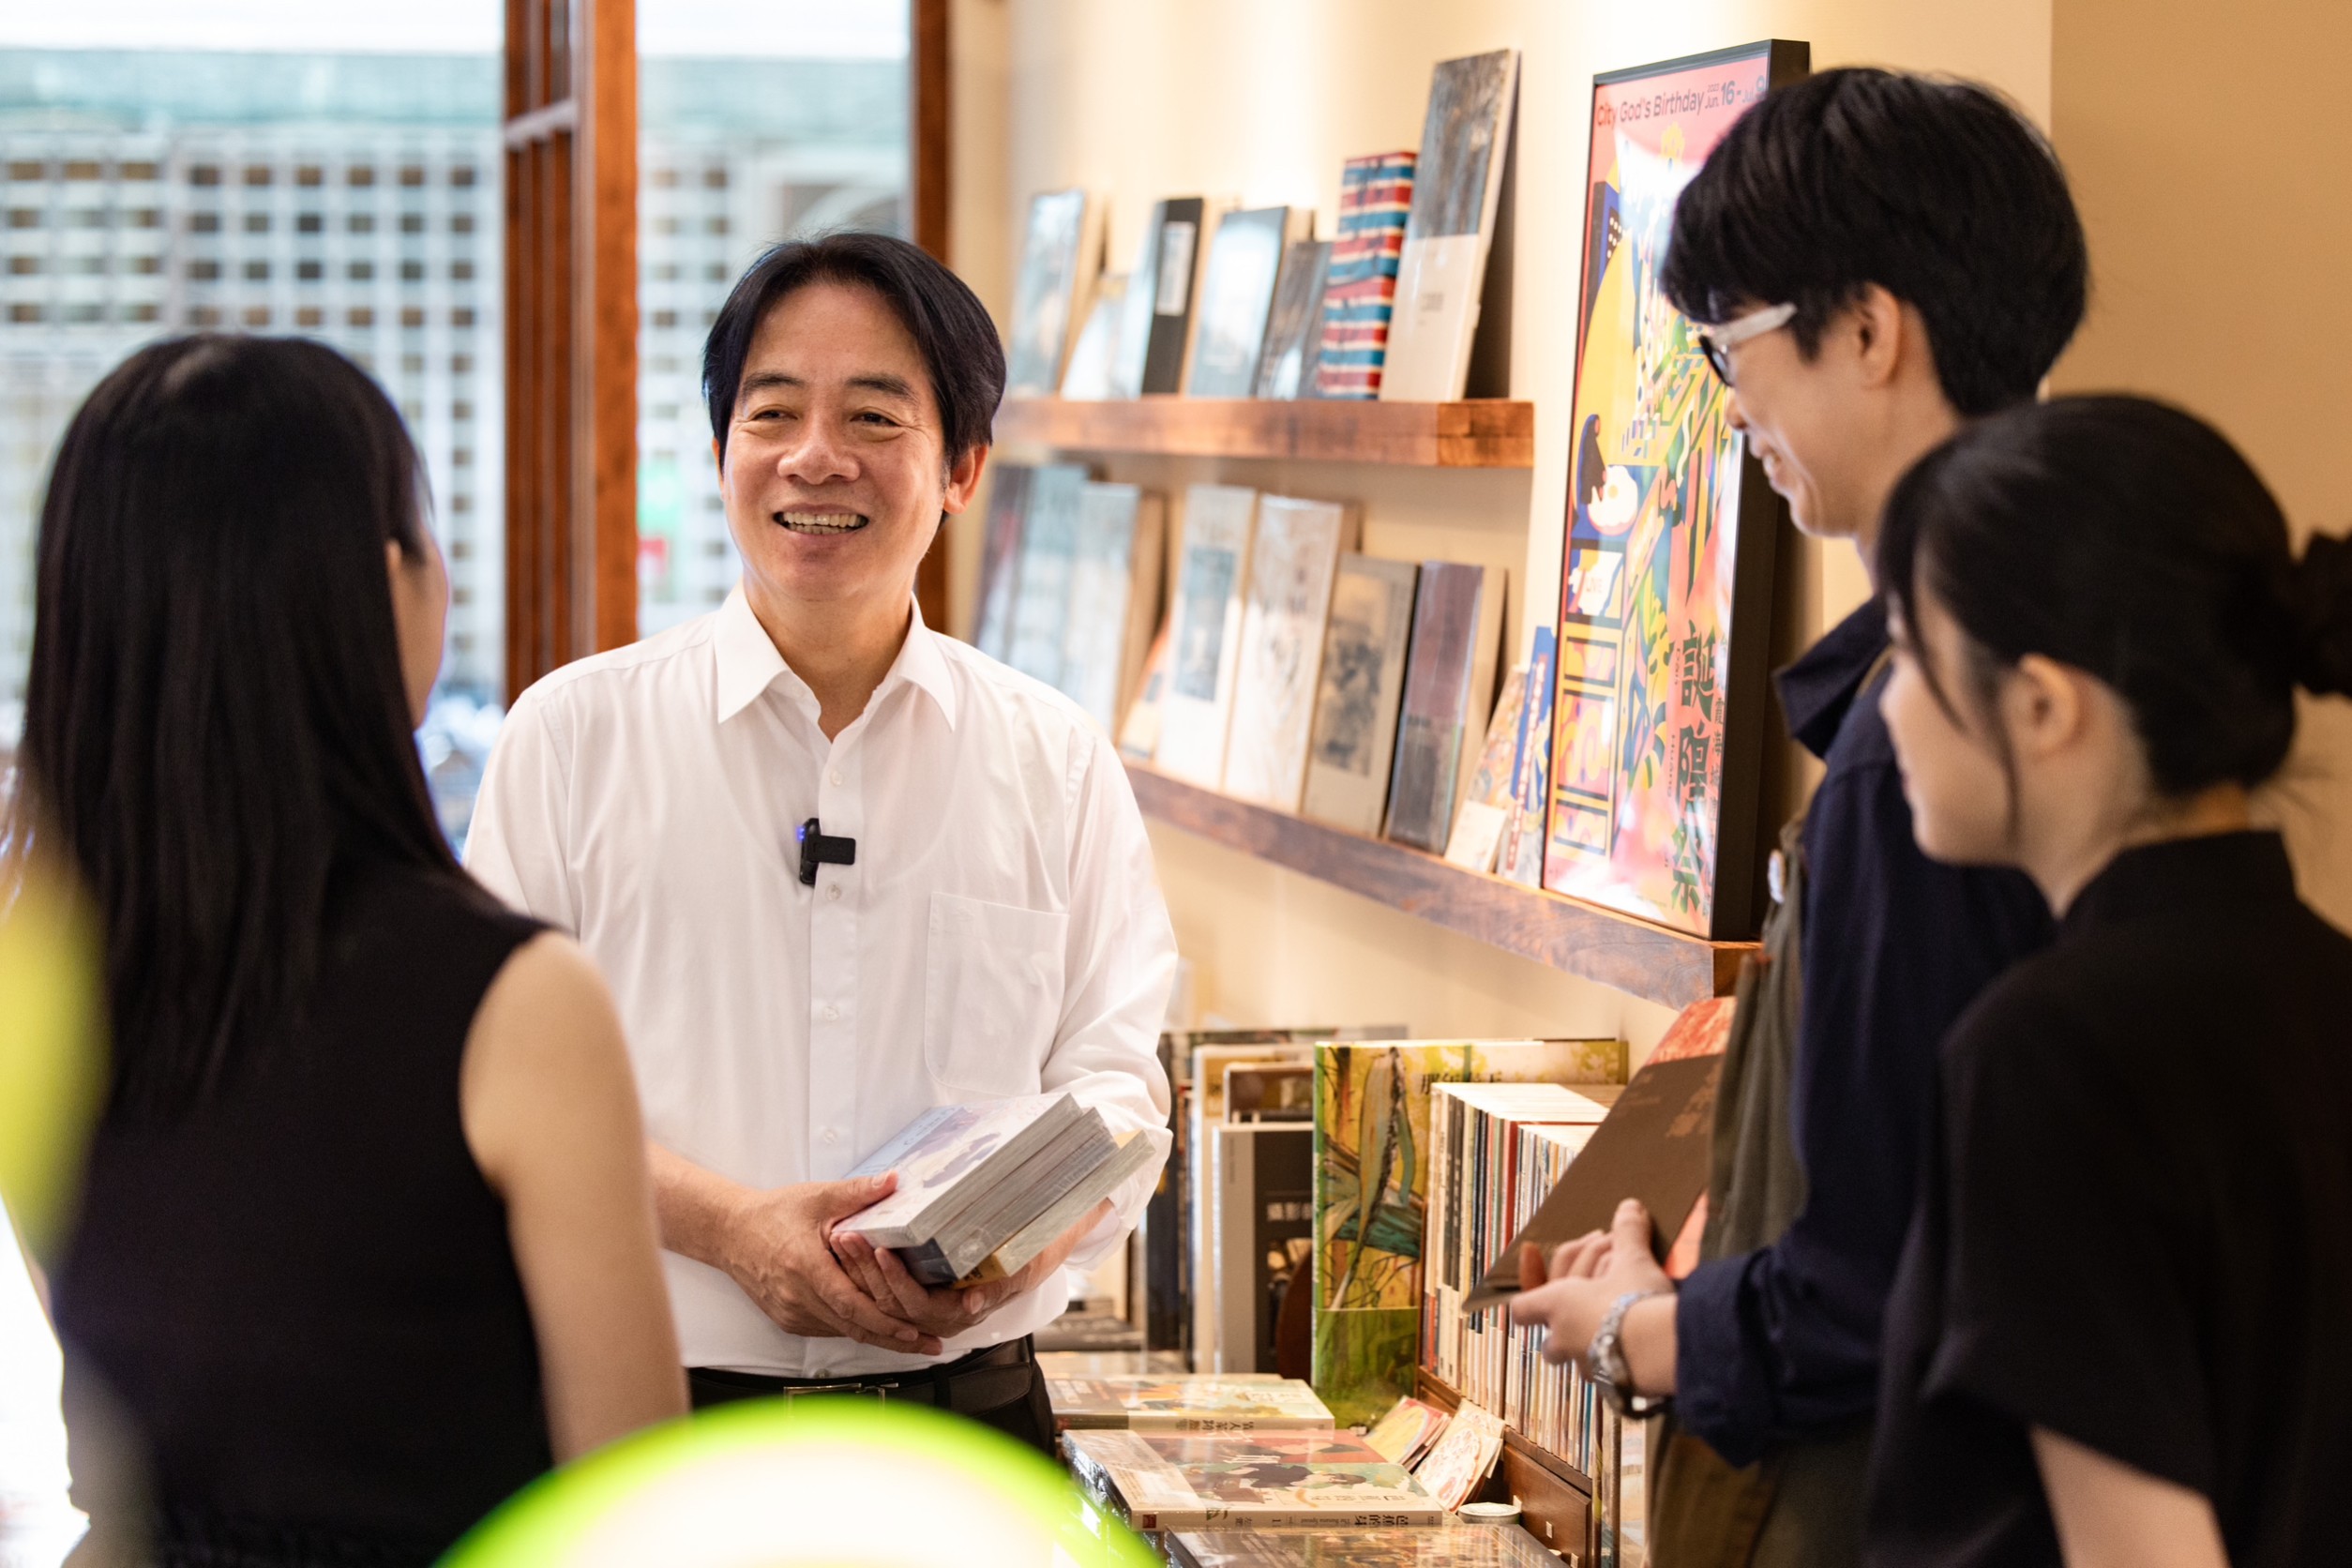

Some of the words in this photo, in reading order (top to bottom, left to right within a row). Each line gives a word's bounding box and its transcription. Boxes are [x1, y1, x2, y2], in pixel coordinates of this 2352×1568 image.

[1597, 101, 1618, 129] City
[1620, 97, 1651, 123] God's
[1653, 89, 1705, 116] Birthday
[1671, 619, 1716, 913] 誕隍祭
